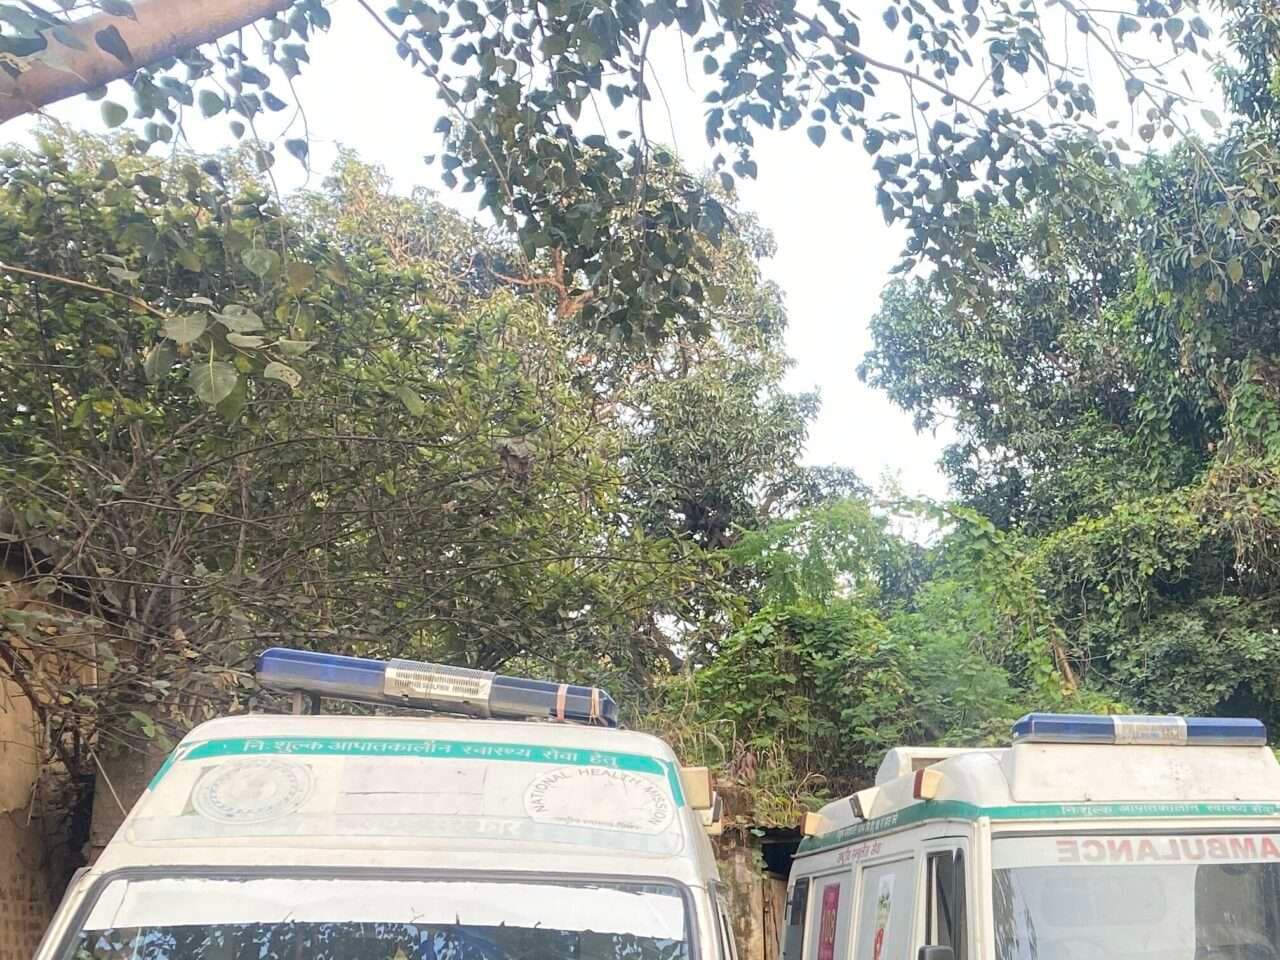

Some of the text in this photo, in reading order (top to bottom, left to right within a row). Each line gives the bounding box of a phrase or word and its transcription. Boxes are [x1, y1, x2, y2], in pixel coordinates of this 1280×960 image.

[529, 767, 668, 826] NATIONAL HEALTH MISSION
